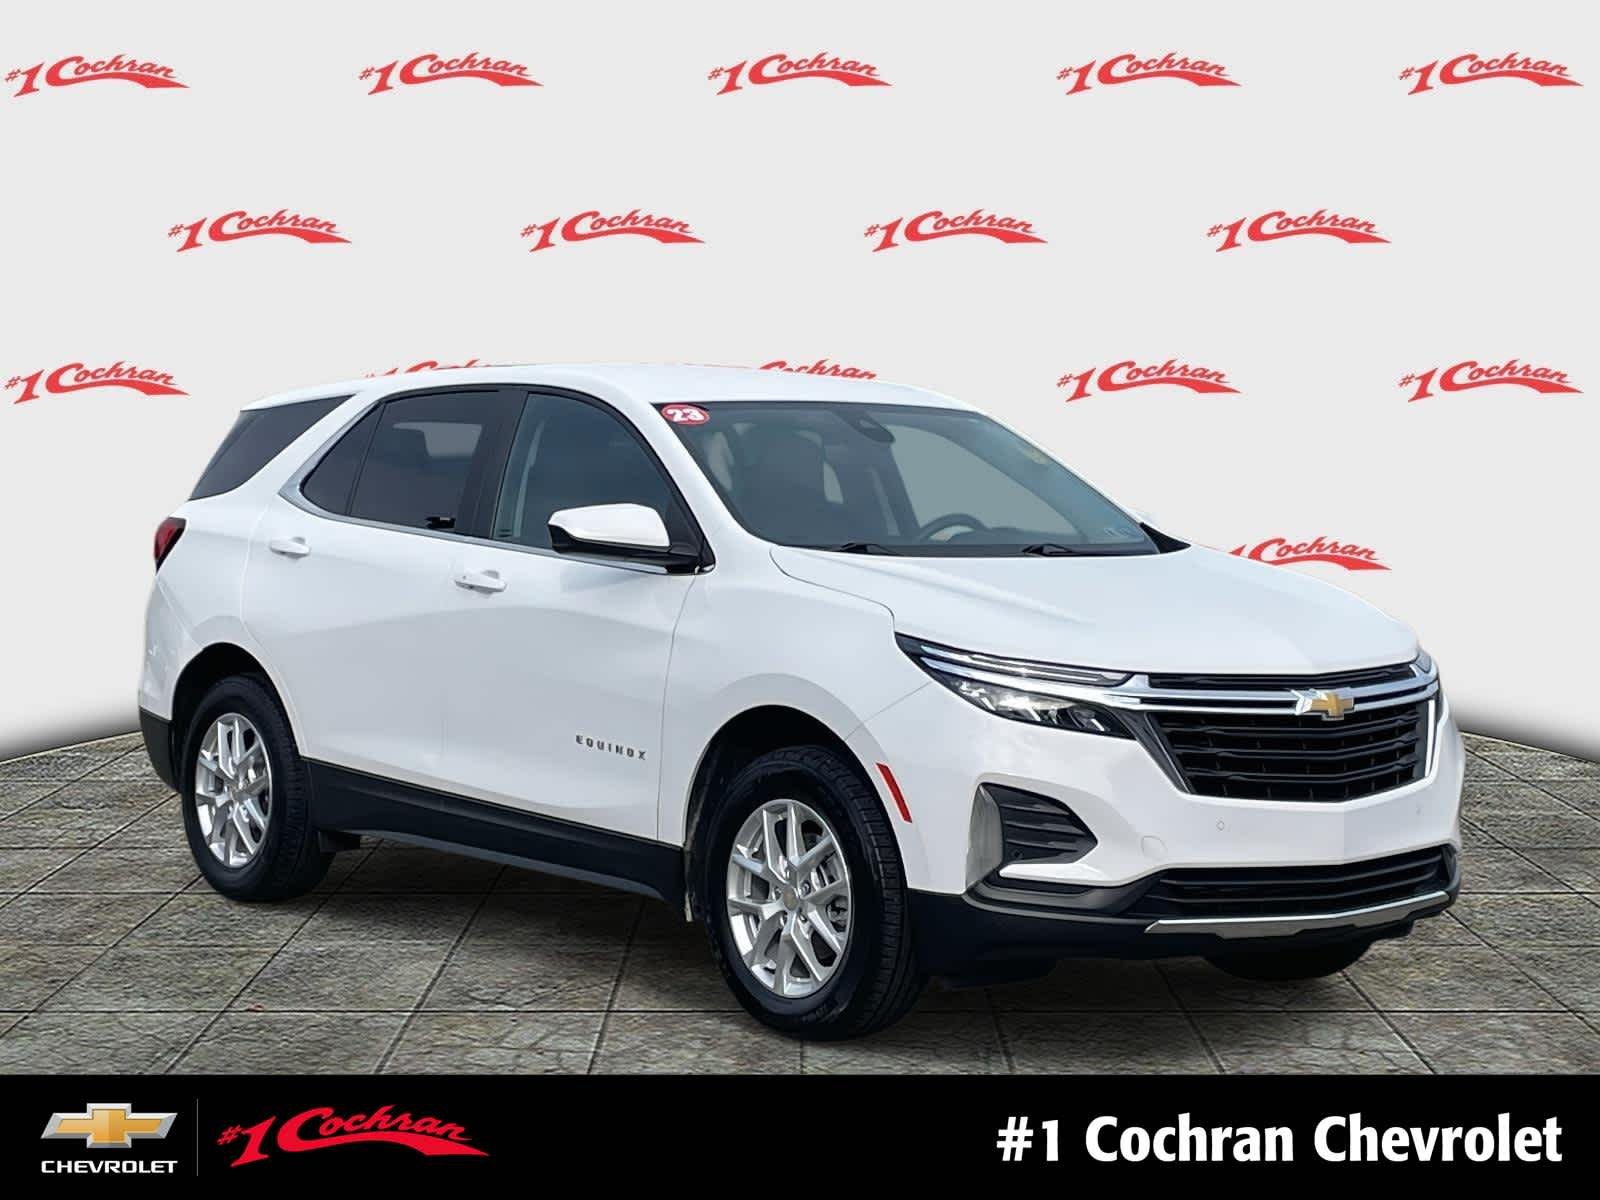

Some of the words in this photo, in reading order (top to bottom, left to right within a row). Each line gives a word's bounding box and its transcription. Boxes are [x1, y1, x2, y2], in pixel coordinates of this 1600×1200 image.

[6, 64, 44, 97] #1
[45, 54, 189, 89] Cochran
[359, 61, 399, 95] #1
[400, 53, 543, 87] Cochran
[709, 61, 748, 95] #1
[747, 53, 892, 87] Cochran
[1057, 61, 1097, 95] #1
[1097, 53, 1241, 87] Cochran
[1399, 61, 1438, 95] #1
[1439, 52, 1583, 87] Cochran
[168, 218, 207, 252] #1
[208, 210, 352, 244] Cochran
[521, 218, 560, 252] #1
[560, 210, 705, 244] Cochran
[864, 218, 903, 252] #1
[904, 209, 1048, 244] Cochran
[1207, 218, 1246, 252] #1
[1246, 209, 1391, 244] Cochran
[5, 370, 44, 403] #1
[45, 361, 189, 396] Cochran
[1057, 368, 1096, 402] #1
[1097, 359, 1241, 394] Cochran
[1399, 368, 1437, 402] #1
[1438, 359, 1583, 394] Cochran
[666, 408, 705, 422] 23
[1247, 536, 1392, 571] Cochran
[575, 734, 647, 761] EQUINOX
